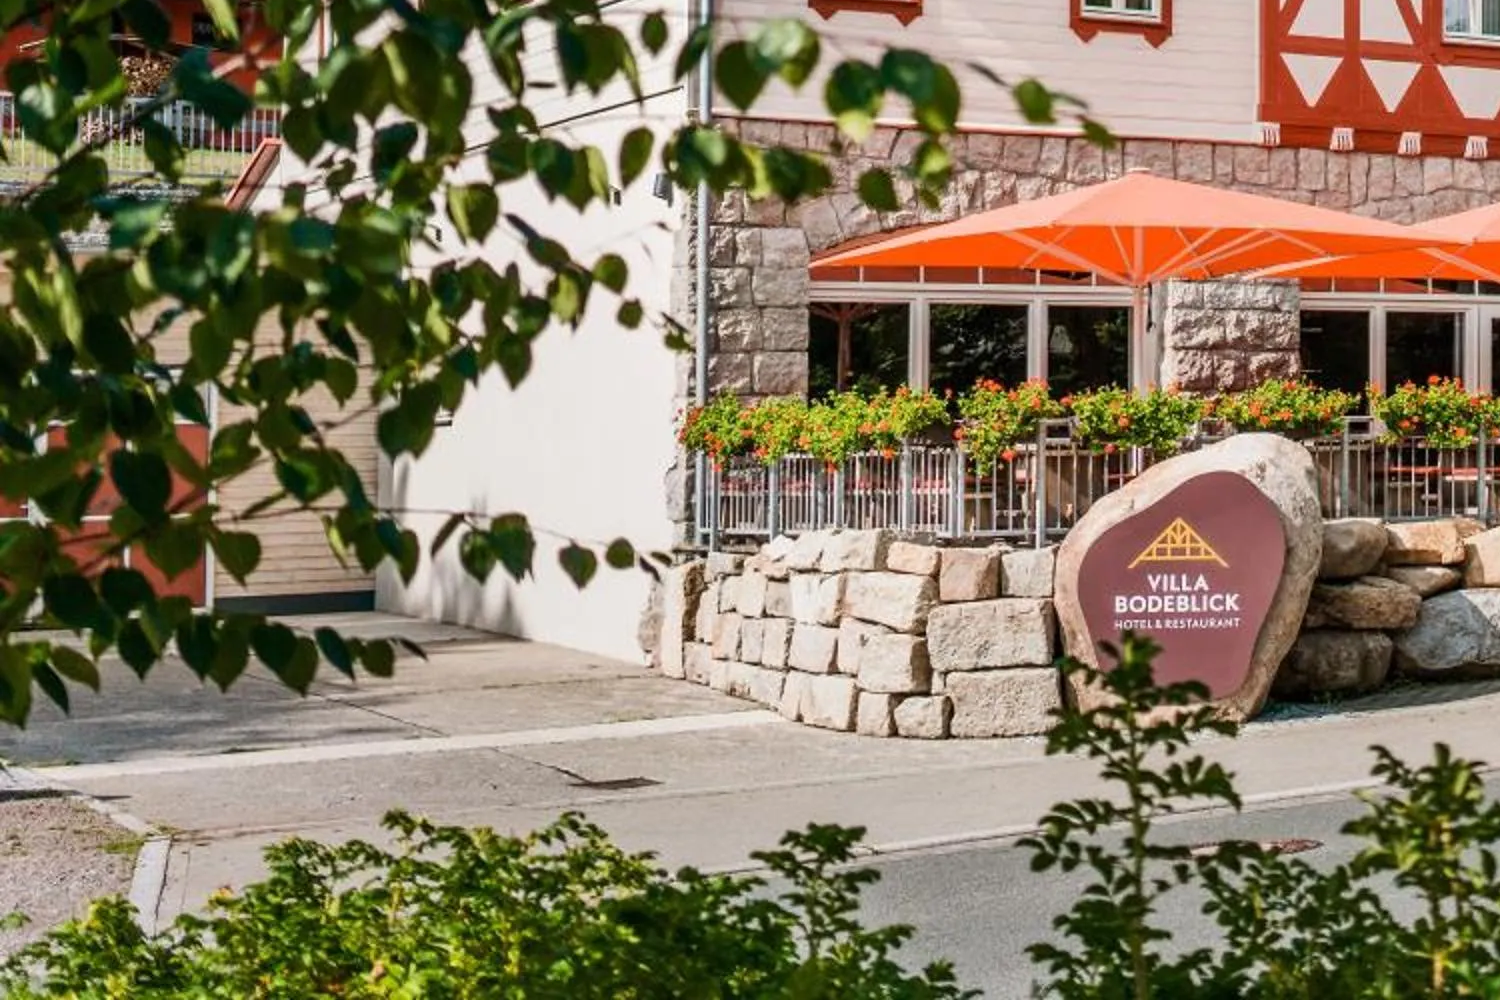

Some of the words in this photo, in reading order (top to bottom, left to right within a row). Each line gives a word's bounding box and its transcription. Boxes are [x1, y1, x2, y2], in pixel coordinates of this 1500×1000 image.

[1148, 574, 1209, 592] VILLA
[1114, 594, 1240, 613] BODEBLICK
[1114, 619, 1152, 630] HOTEL
[1155, 619, 1163, 629] &
[1164, 617, 1241, 629] RESTAURANT
